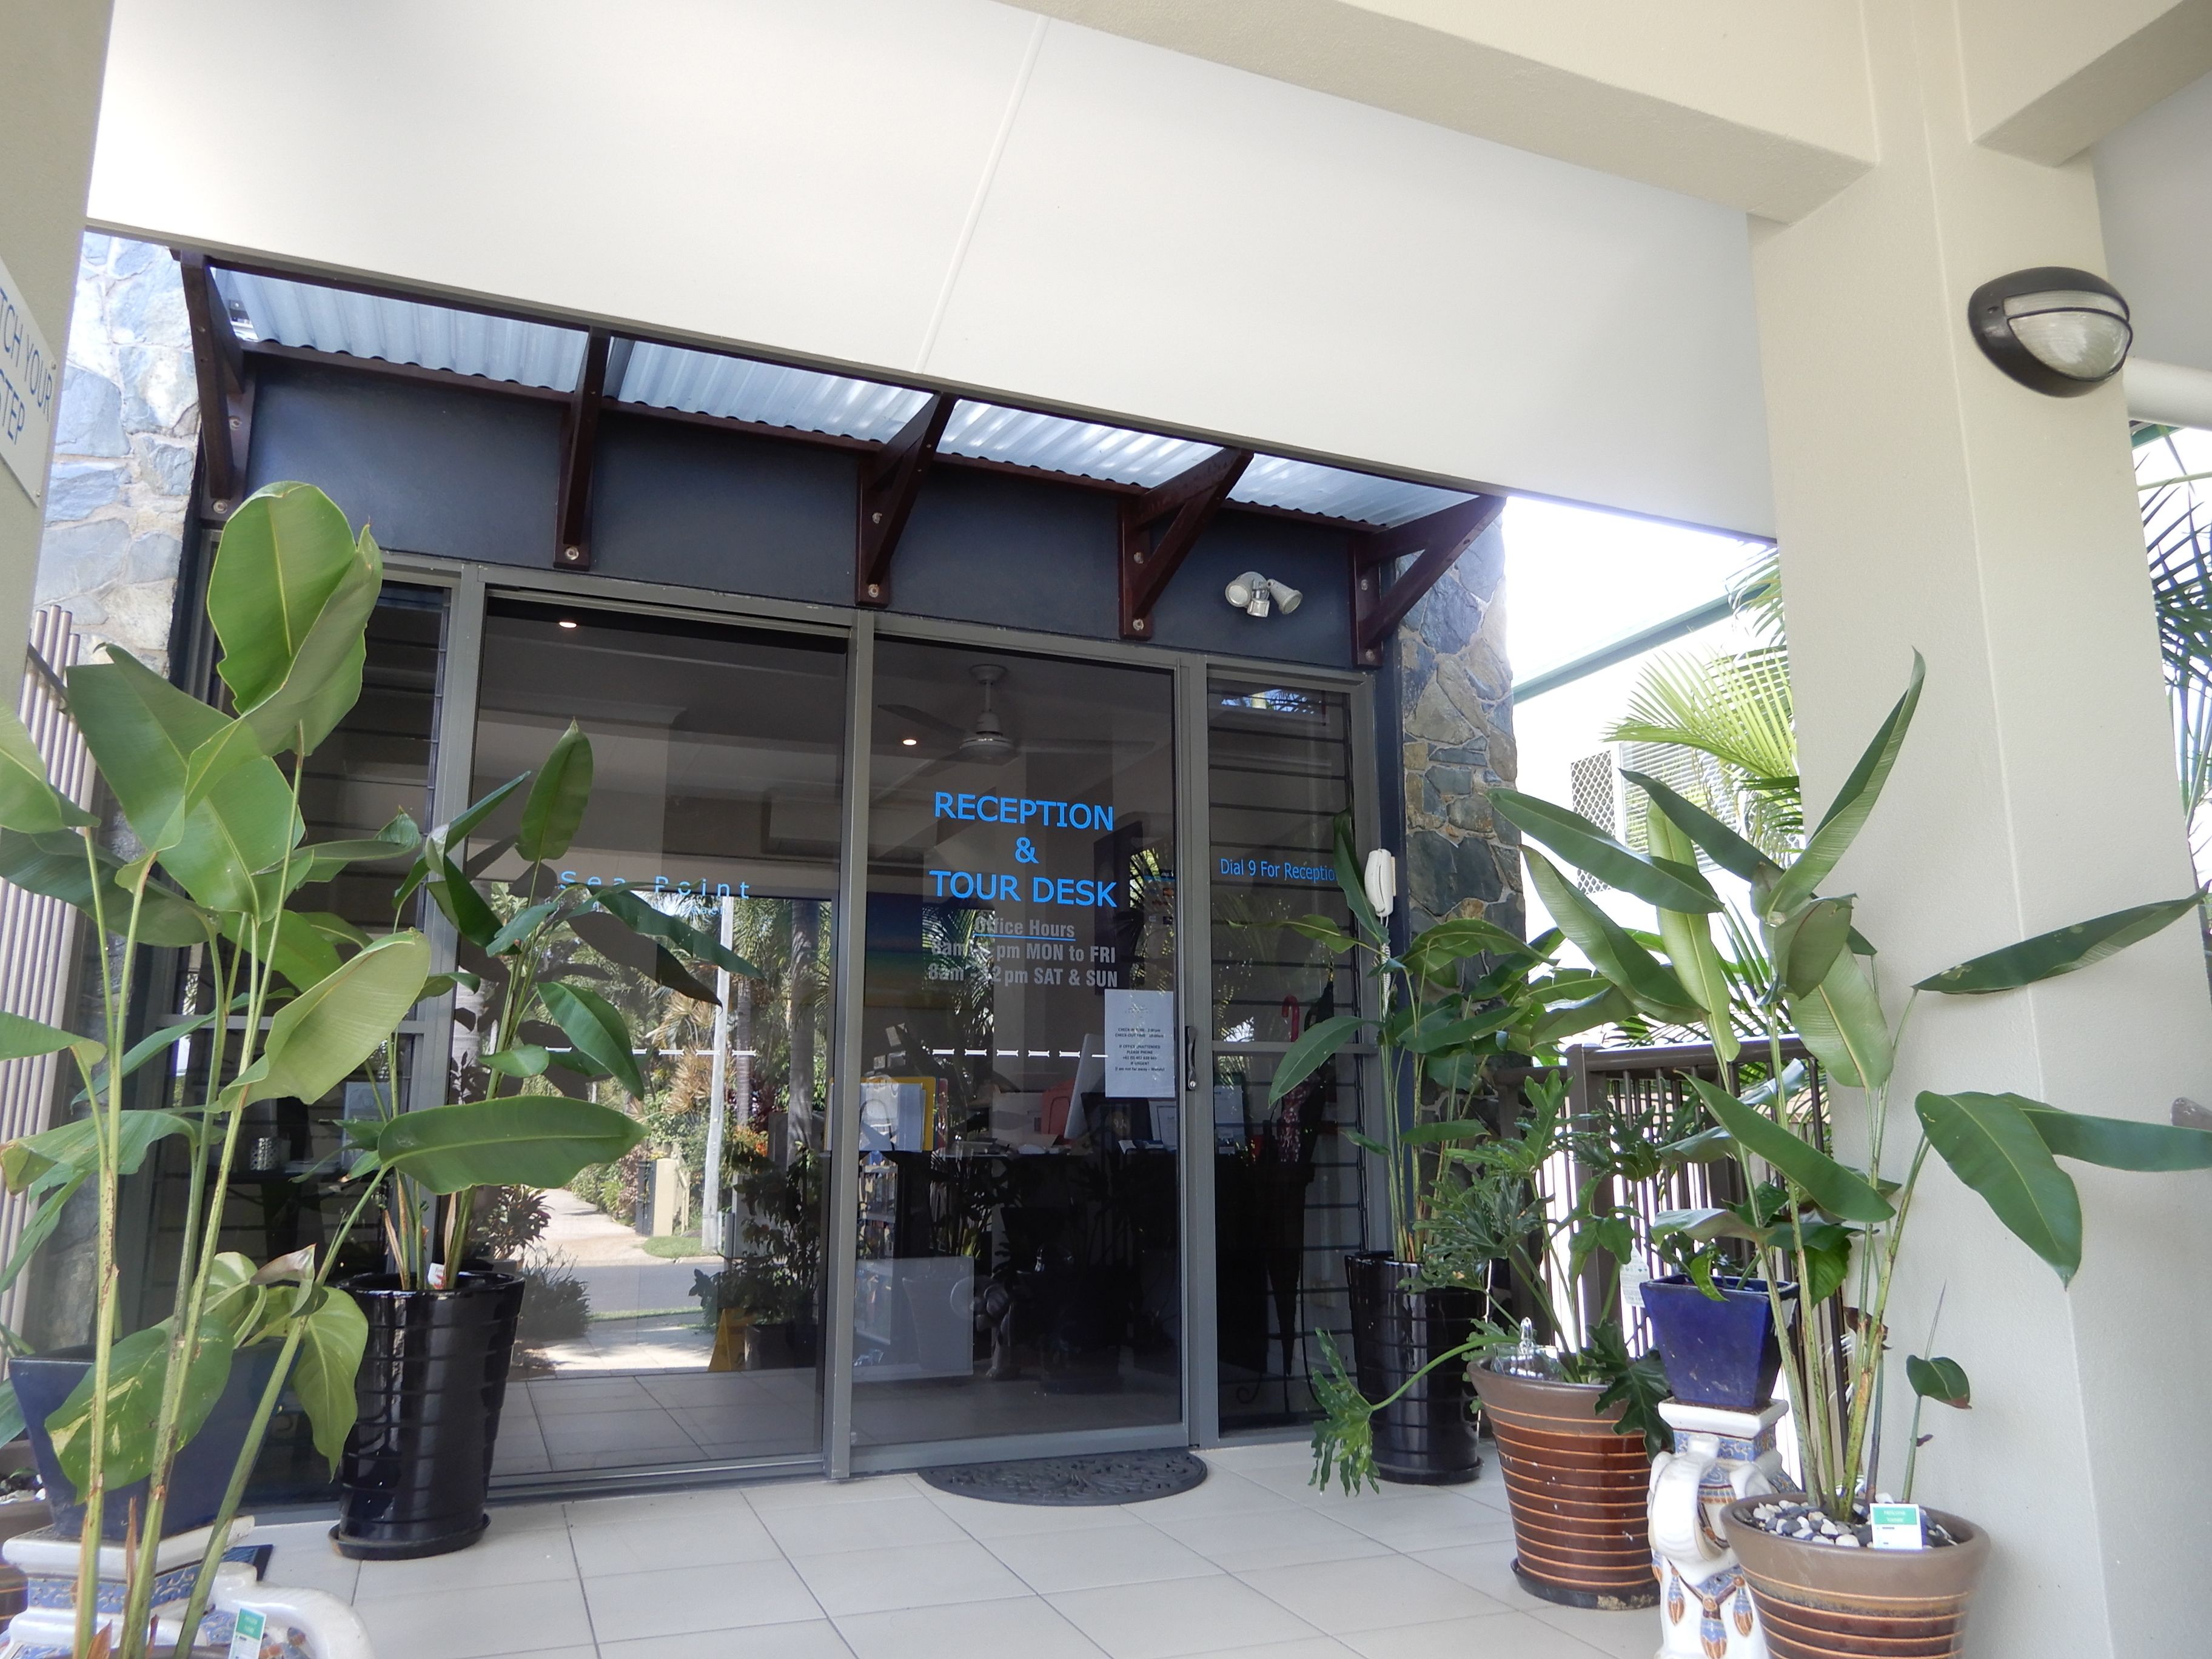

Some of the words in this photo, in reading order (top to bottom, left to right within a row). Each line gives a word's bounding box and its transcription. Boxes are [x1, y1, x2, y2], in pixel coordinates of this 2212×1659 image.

[24, 334, 53, 423] YOUR
[934, 791, 1114, 831] RECEPTION
[1014, 836, 1039, 864] &
[1220, 858, 1244, 876] Dial
[1248, 860, 1256, 876] 9
[1261, 860, 1281, 877] For
[1284, 862, 1337, 883] Receptio
[654, 875, 750, 900] Point
[928, 870, 1021, 902] TOUR
[1033, 877, 1118, 908] DESK
[974, 916, 1024, 936] Office
[1029, 919, 1075, 937] Hours
[1026, 943, 1064, 962] MON
[1069, 945, 1085, 962] to
[1090, 945, 1116, 964] FRI
[928, 963, 965, 981] 8am
[1033, 967, 1064, 985] SAT
[1068, 969, 1081, 986] &
[1086, 970, 1118, 988] SUN
